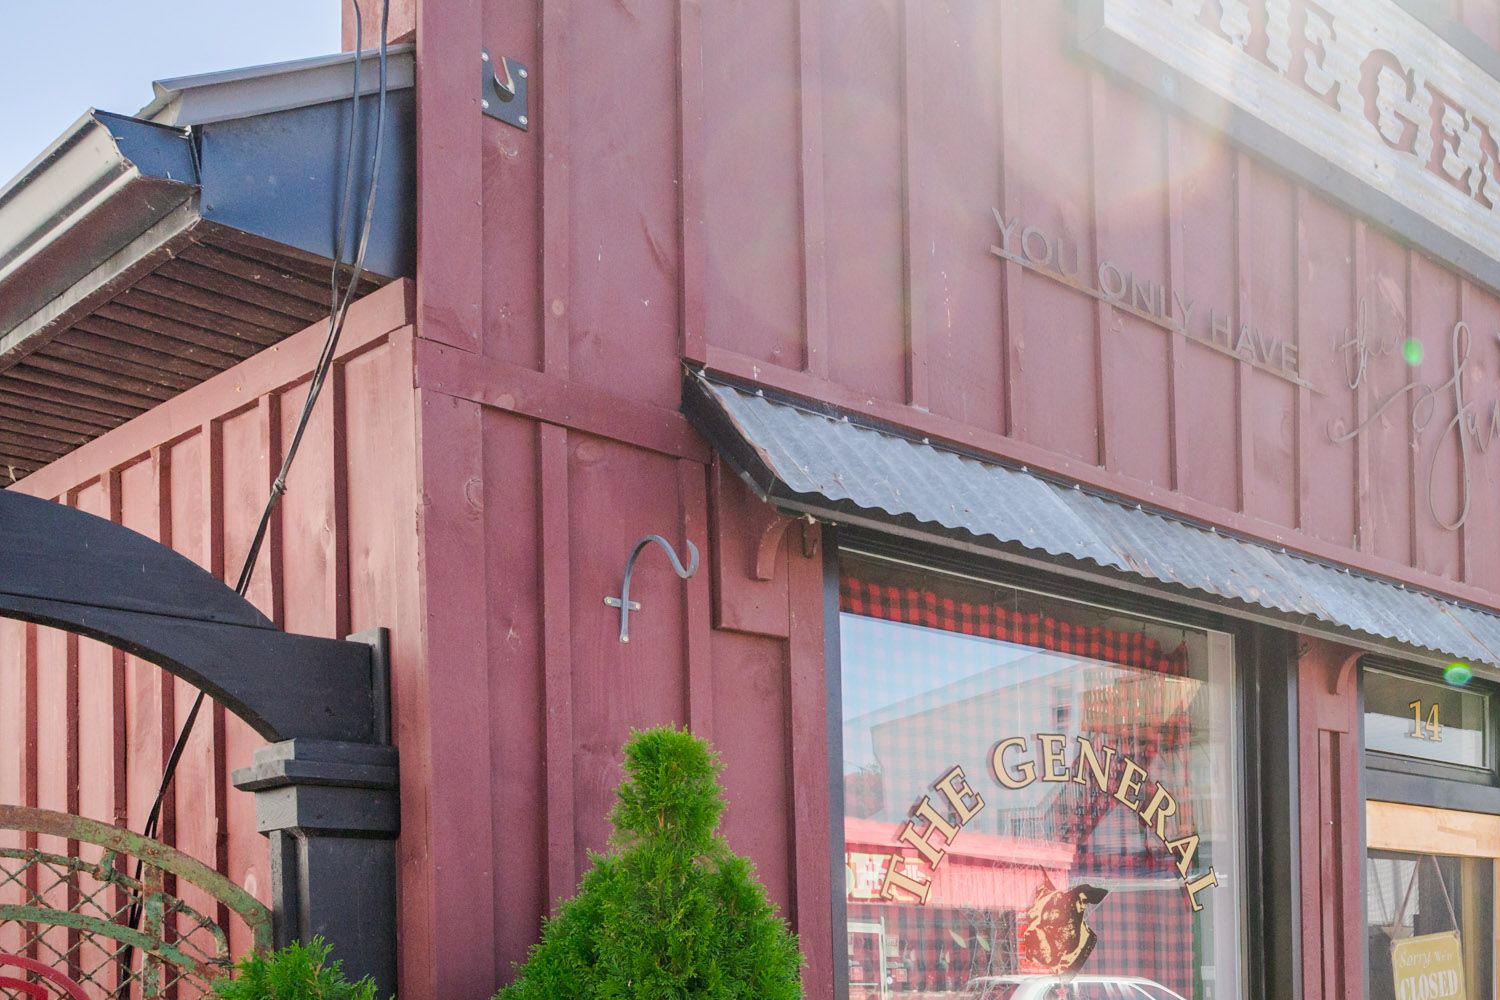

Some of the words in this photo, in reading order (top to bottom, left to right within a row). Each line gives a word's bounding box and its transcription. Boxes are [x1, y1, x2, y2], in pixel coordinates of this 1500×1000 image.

[1162, 0, 1342, 112] HE
[991, 207, 1079, 277] YOU
[1098, 260, 1195, 331] ONLY
[1210, 308, 1299, 374] HAVE
[1408, 699, 1442, 742] 14
[879, 764, 986, 906] THE
[993, 733, 1219, 912] GENERAL
[1400, 951, 1431, 969] Sorry
